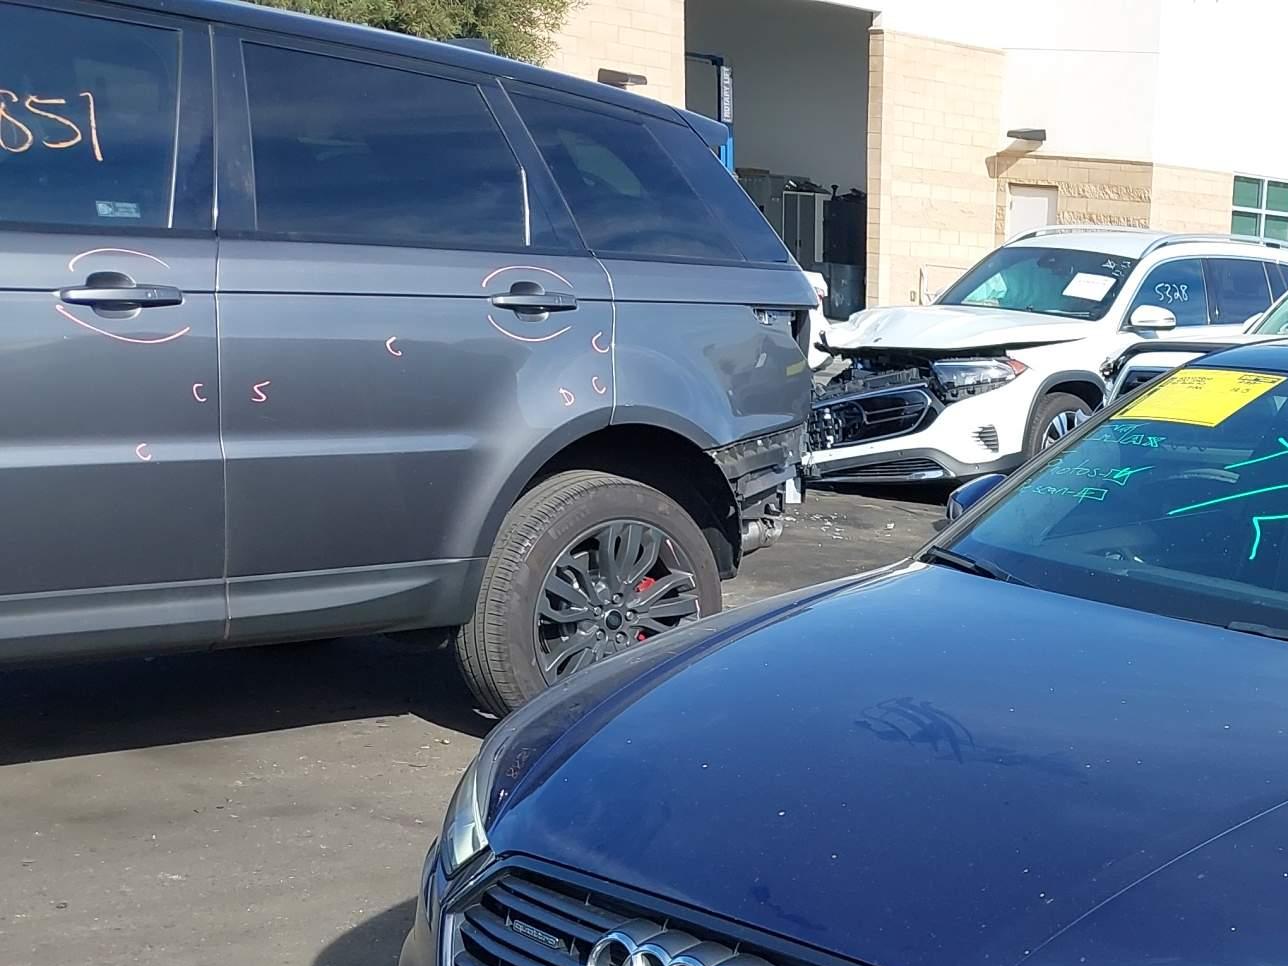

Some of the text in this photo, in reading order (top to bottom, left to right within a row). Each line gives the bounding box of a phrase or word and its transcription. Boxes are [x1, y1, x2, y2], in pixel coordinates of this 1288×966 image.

[723, 86, 731, 118] ROTARY
[1154, 283, 1189, 303] 5328
[514, 922, 556, 946] quattro
